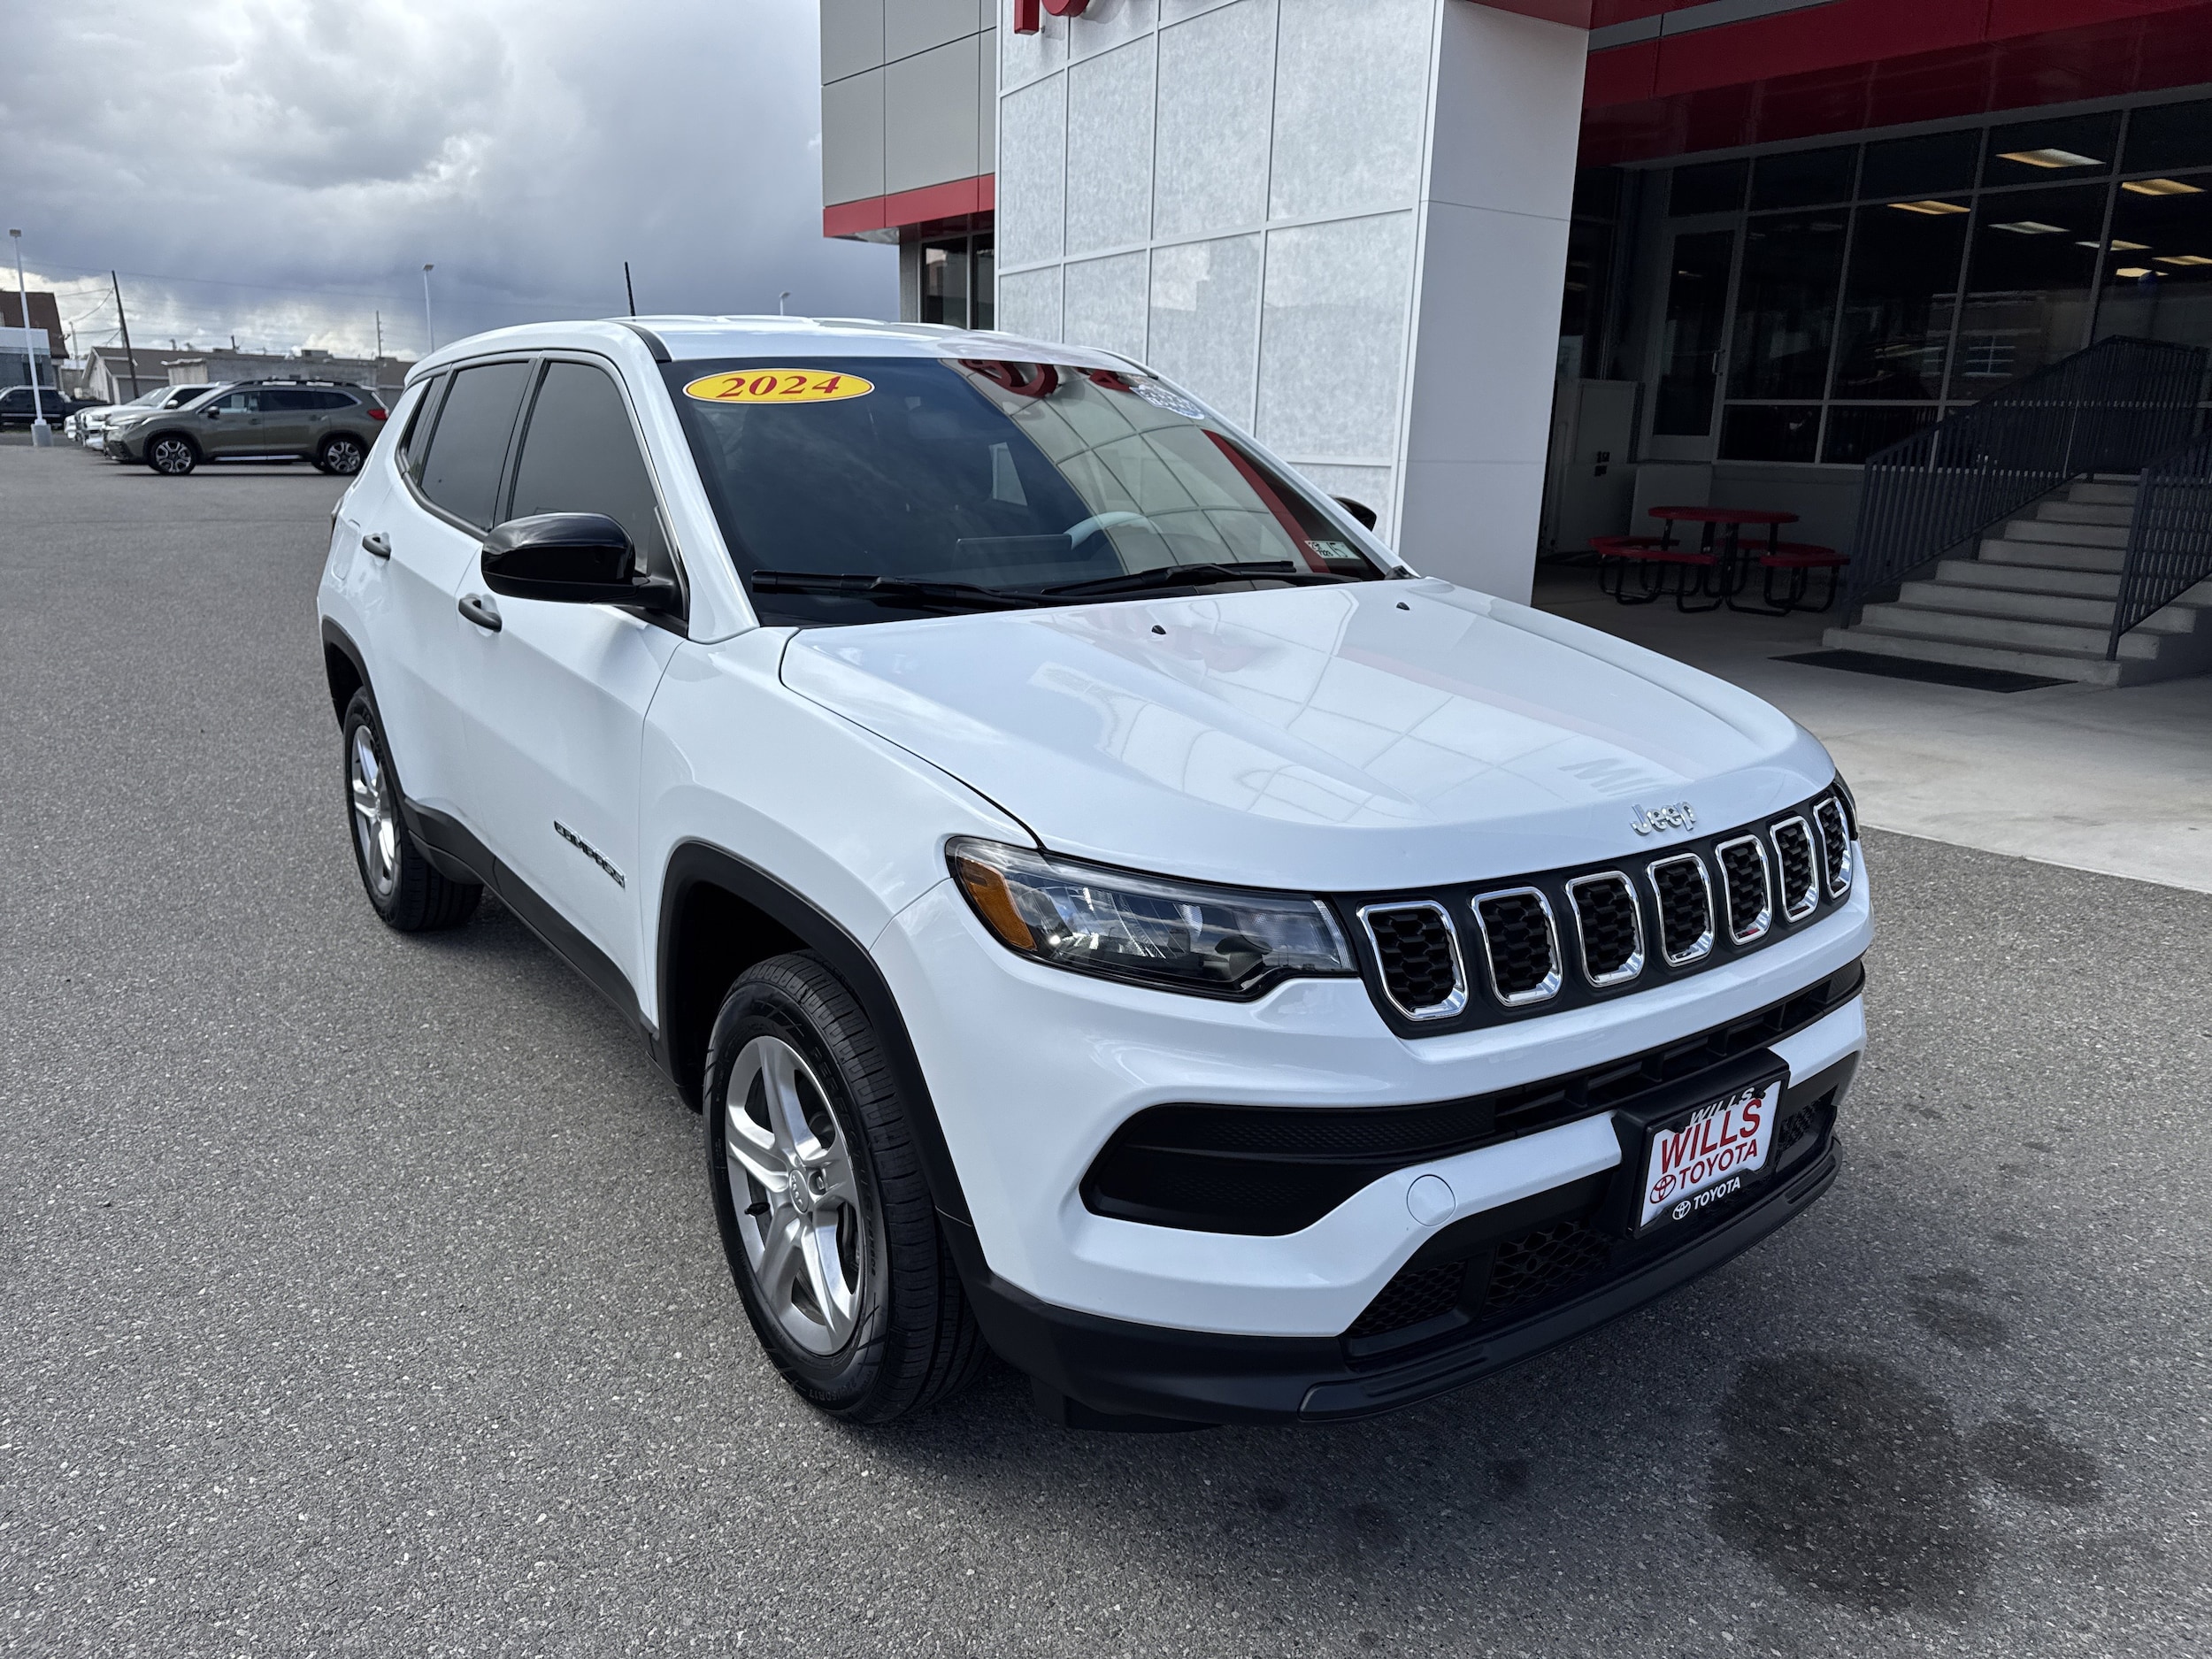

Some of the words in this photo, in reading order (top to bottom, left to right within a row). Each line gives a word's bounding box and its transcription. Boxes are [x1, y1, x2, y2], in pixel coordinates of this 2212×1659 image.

[716, 375, 841, 398] 2024
[1630, 802, 1696, 836] Jeep
[1689, 1087, 1755, 1125] WILLS
[1662, 1099, 1763, 1174] WILLS
[1679, 1139, 1757, 1189] TOYOTA
[1694, 1177, 1741, 1210] TOYOTA
